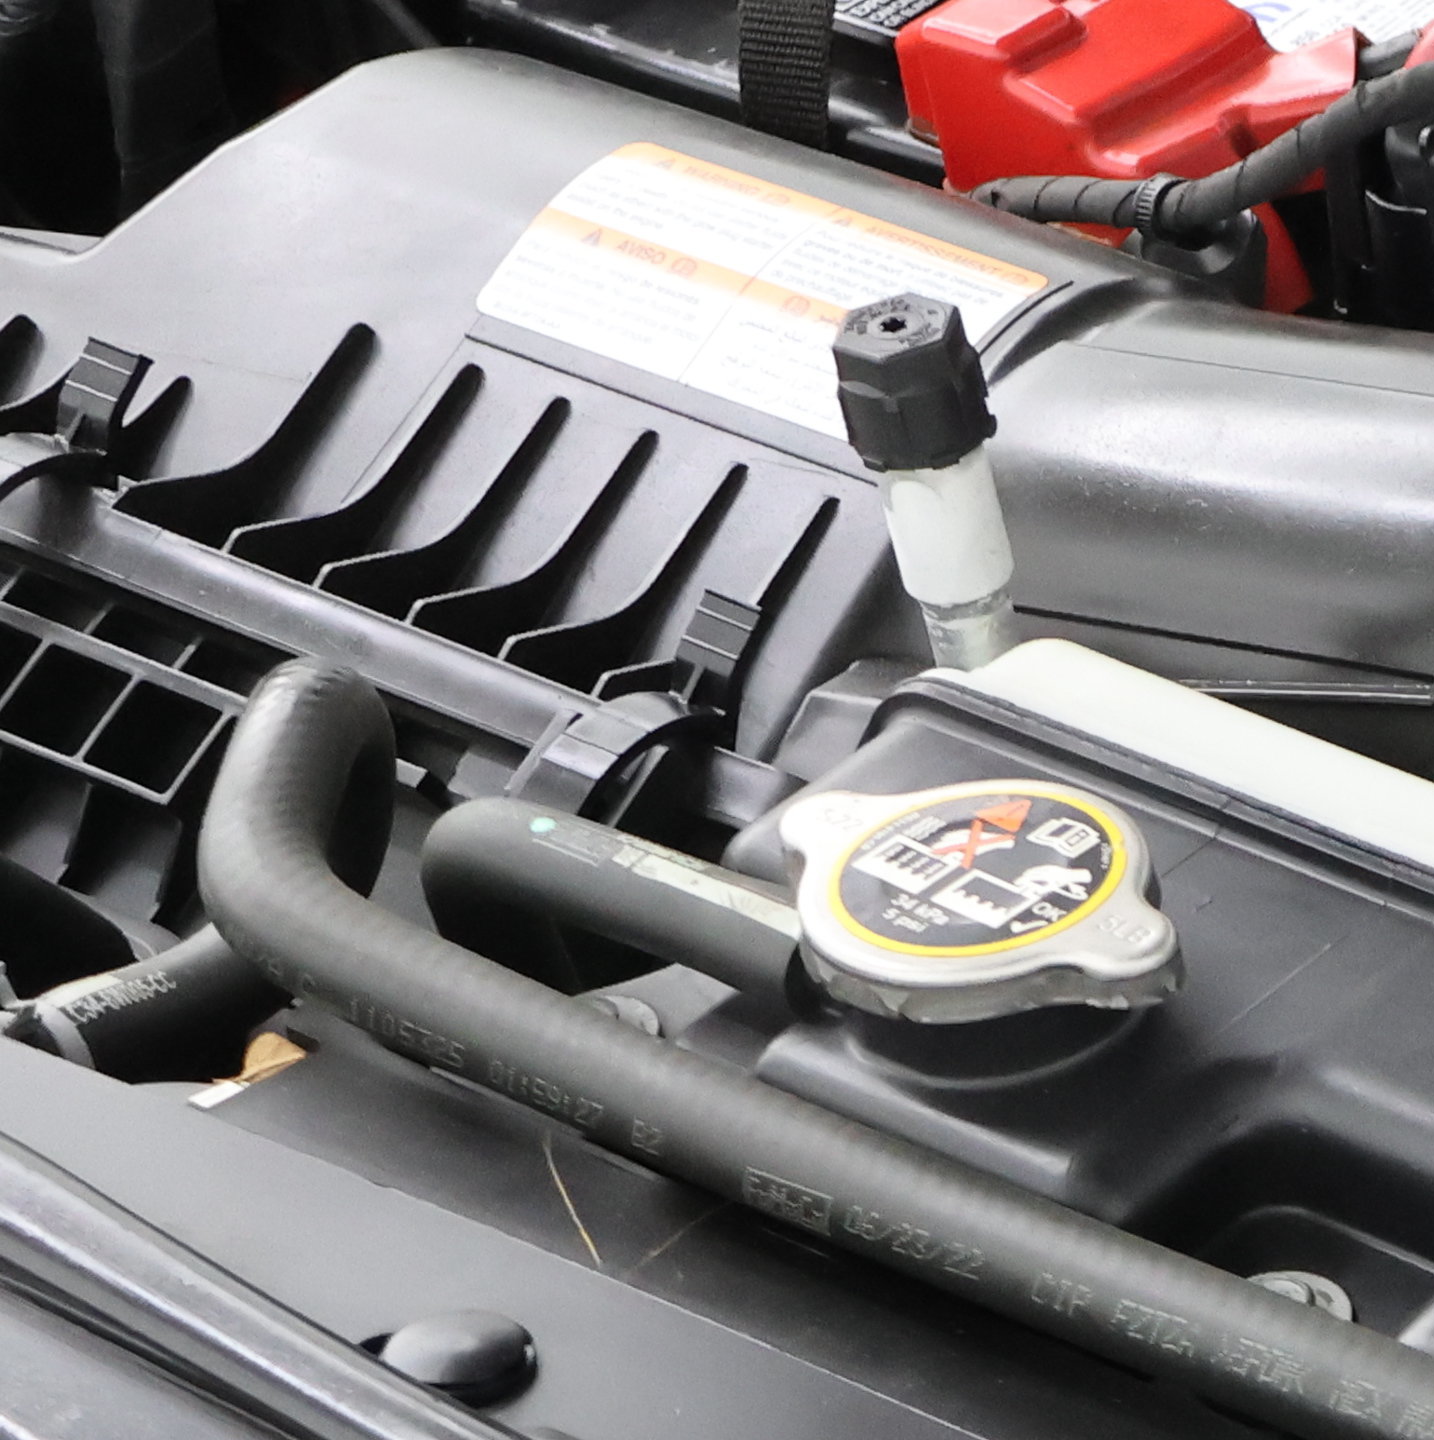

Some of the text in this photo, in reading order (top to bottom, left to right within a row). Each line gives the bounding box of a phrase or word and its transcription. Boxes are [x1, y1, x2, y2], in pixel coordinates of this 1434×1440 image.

[613, 237, 668, 268] AVISO
[881, 908, 929, 935] 5 psi
[889, 892, 952, 926] 34 kPa
[1031, 899, 1068, 922] OK
